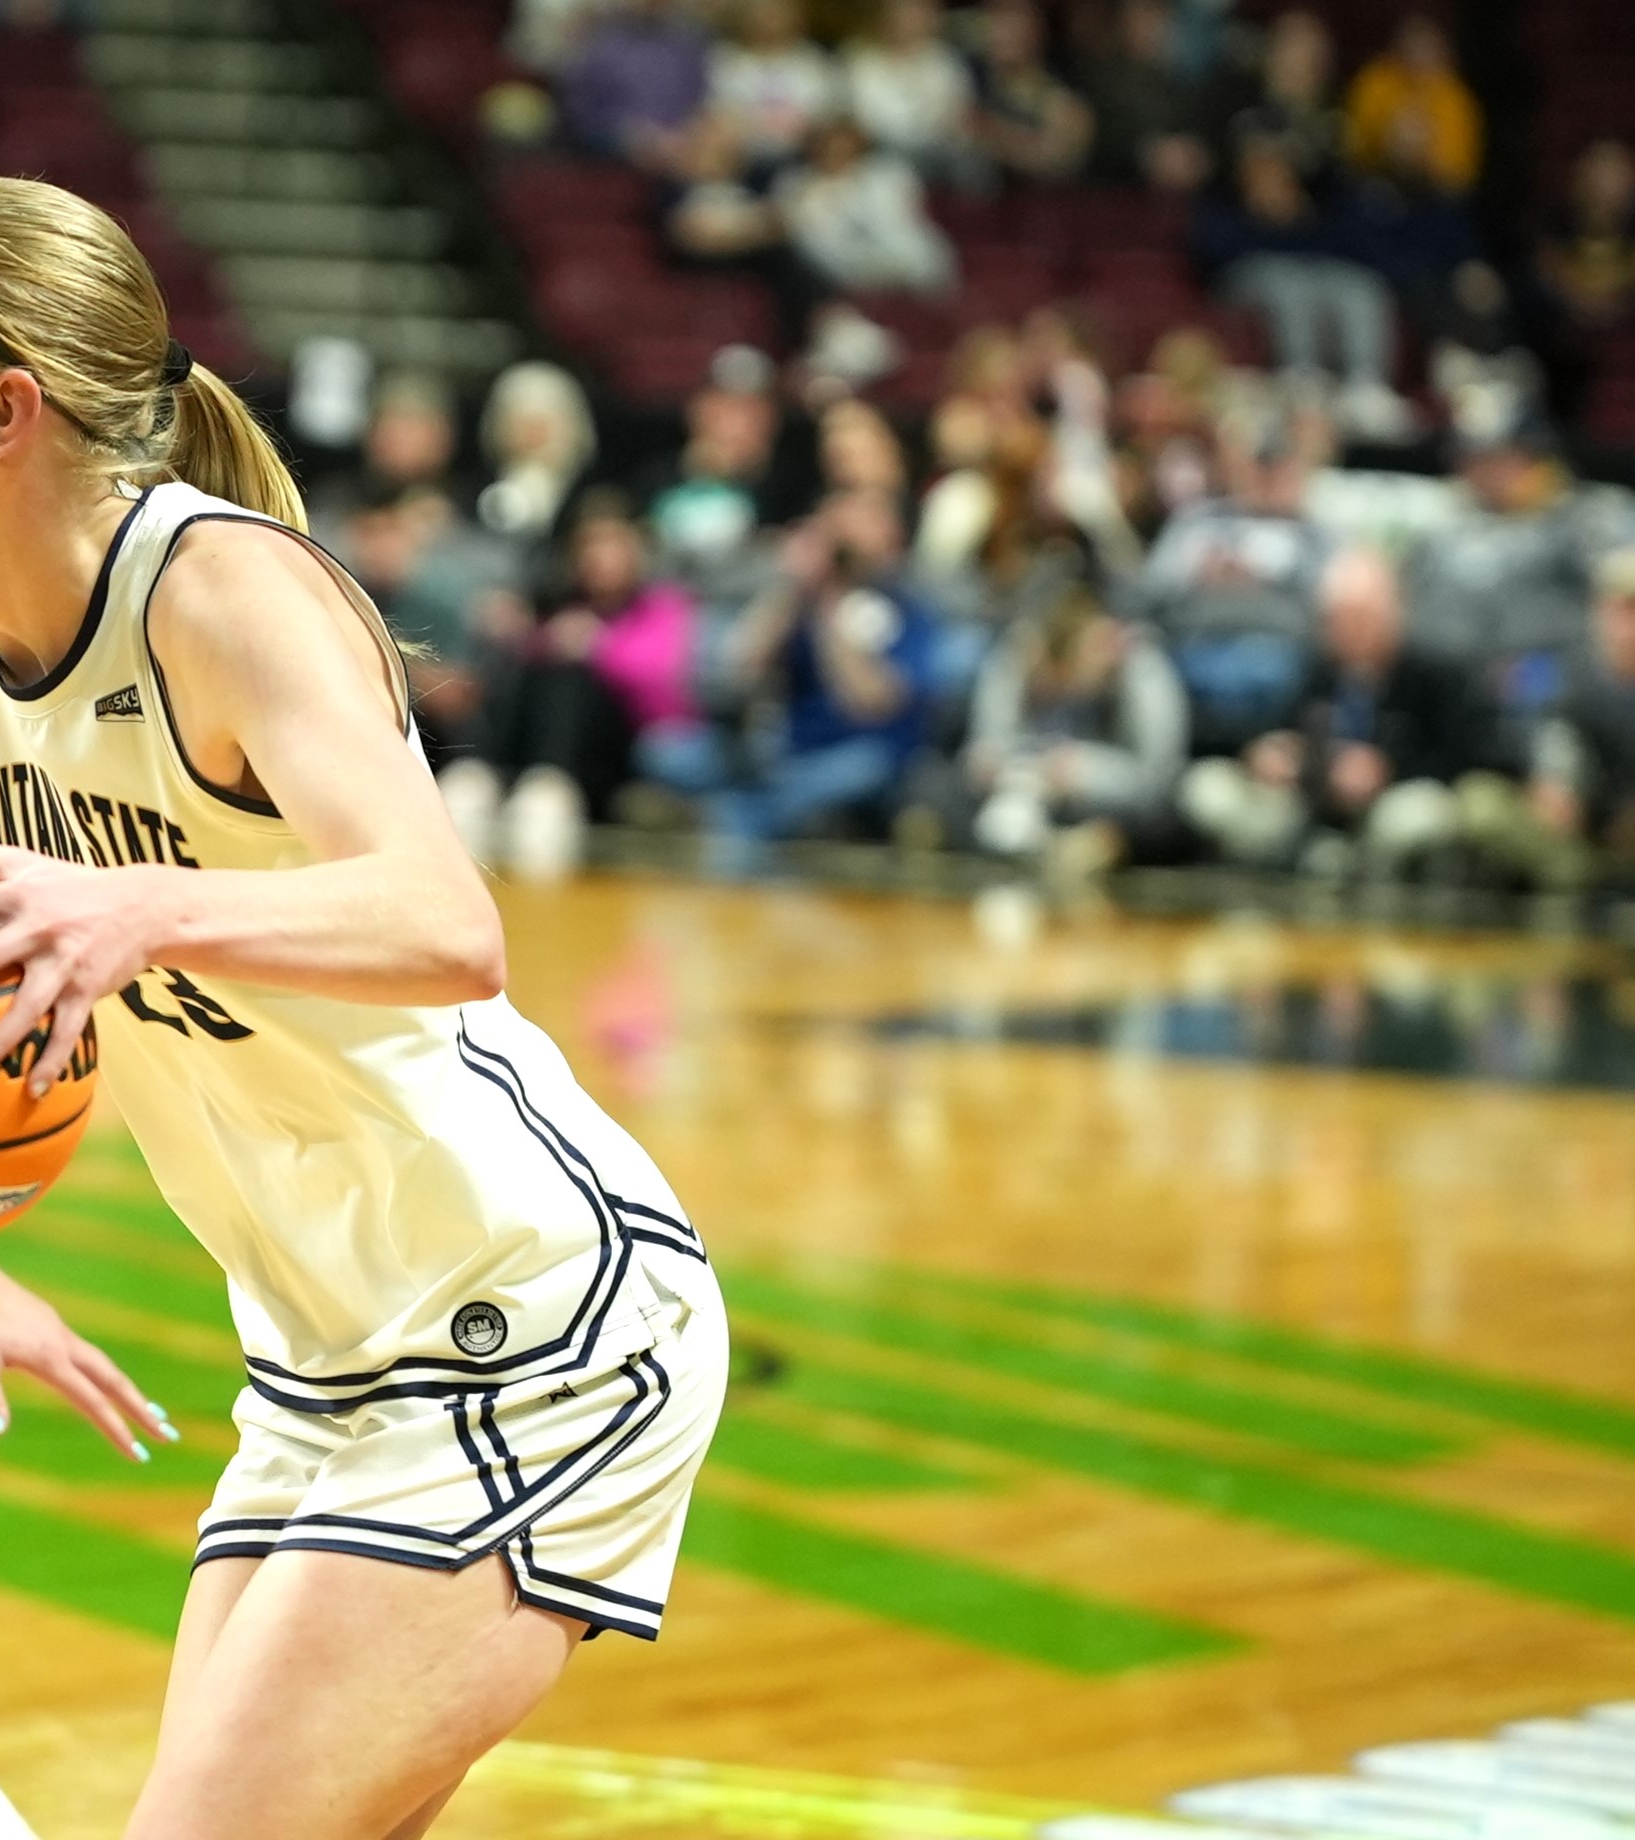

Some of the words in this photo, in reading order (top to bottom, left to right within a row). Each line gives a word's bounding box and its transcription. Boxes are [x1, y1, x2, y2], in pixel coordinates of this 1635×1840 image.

[114, 687, 140, 710] SKY
[69, 788, 203, 869] STATE
[466, 1318, 492, 1335] SM
